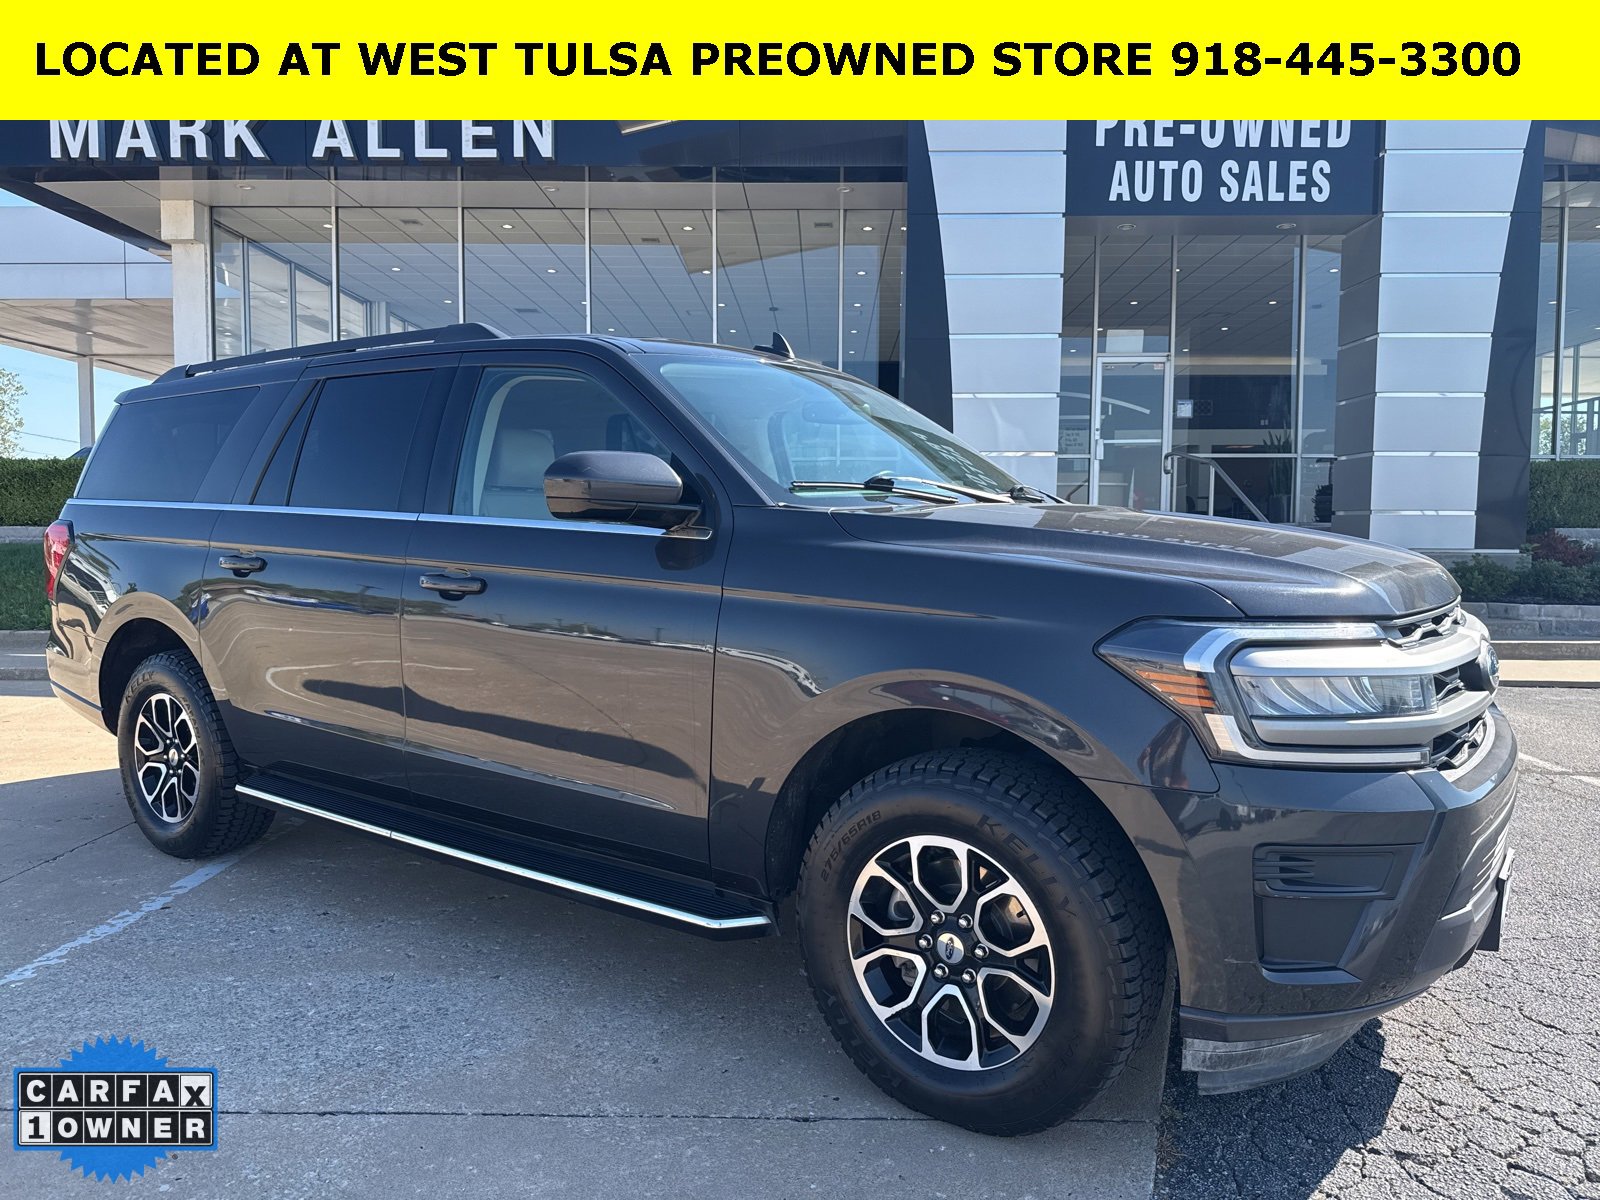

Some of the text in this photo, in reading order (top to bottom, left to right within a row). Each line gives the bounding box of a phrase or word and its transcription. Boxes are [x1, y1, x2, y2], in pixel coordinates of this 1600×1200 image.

[50, 120, 554, 159] MARK ALLEN
[1095, 120, 1351, 148] PRE-OWNED
[1108, 159, 1331, 203] AUTO SALES
[125, 670, 154, 704] KELLY
[821, 810, 881, 882] 275/65R18
[977, 814, 1077, 917] KELLY
